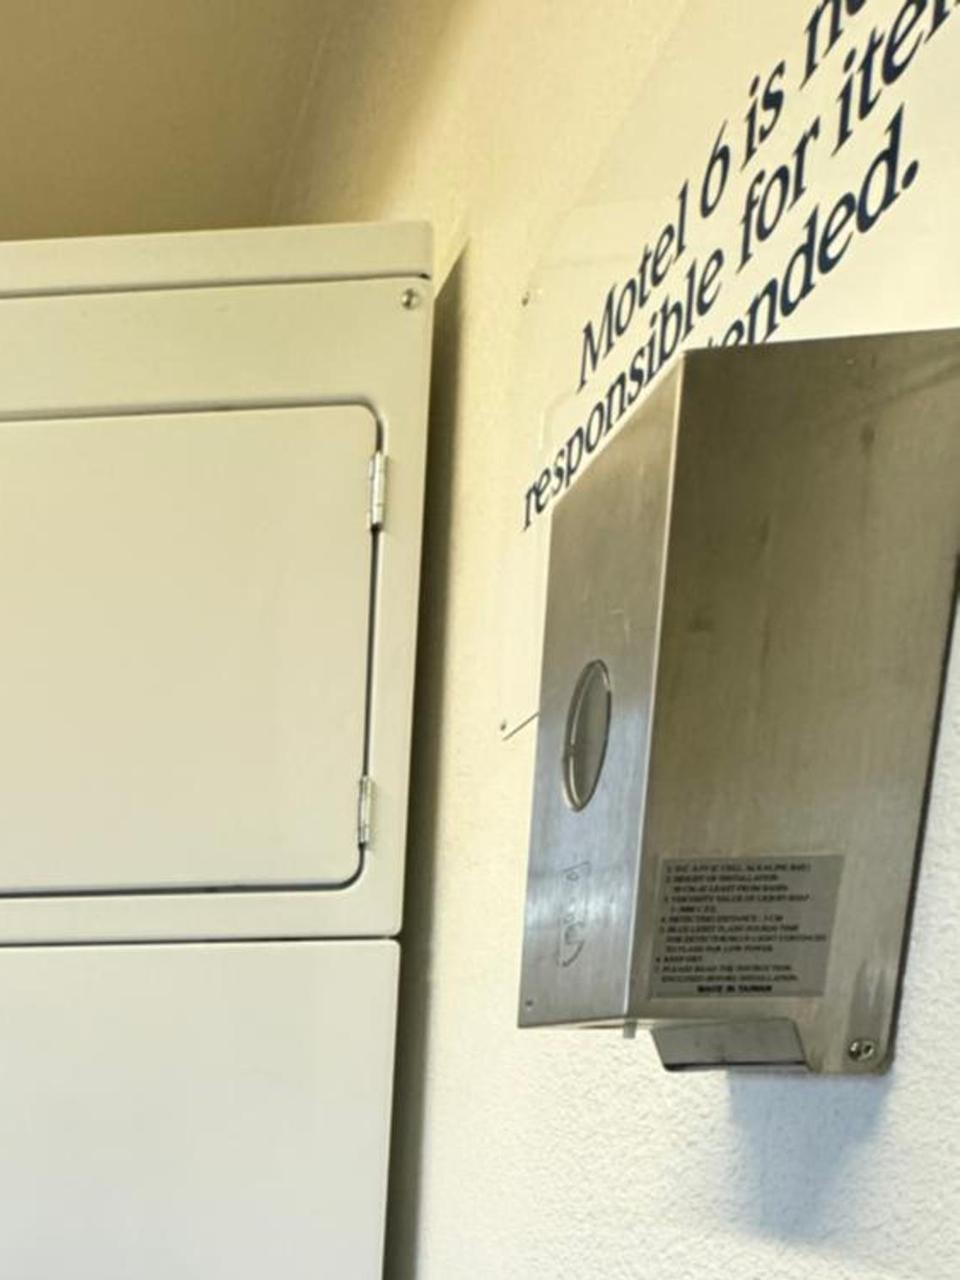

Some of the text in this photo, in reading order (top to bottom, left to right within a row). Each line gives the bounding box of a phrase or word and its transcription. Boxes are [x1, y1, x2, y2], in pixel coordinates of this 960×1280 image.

[521, 248, 724, 533] responsible
[736, 116, 821, 274] for
[576, 0, 867, 394] Motel 6 is n
